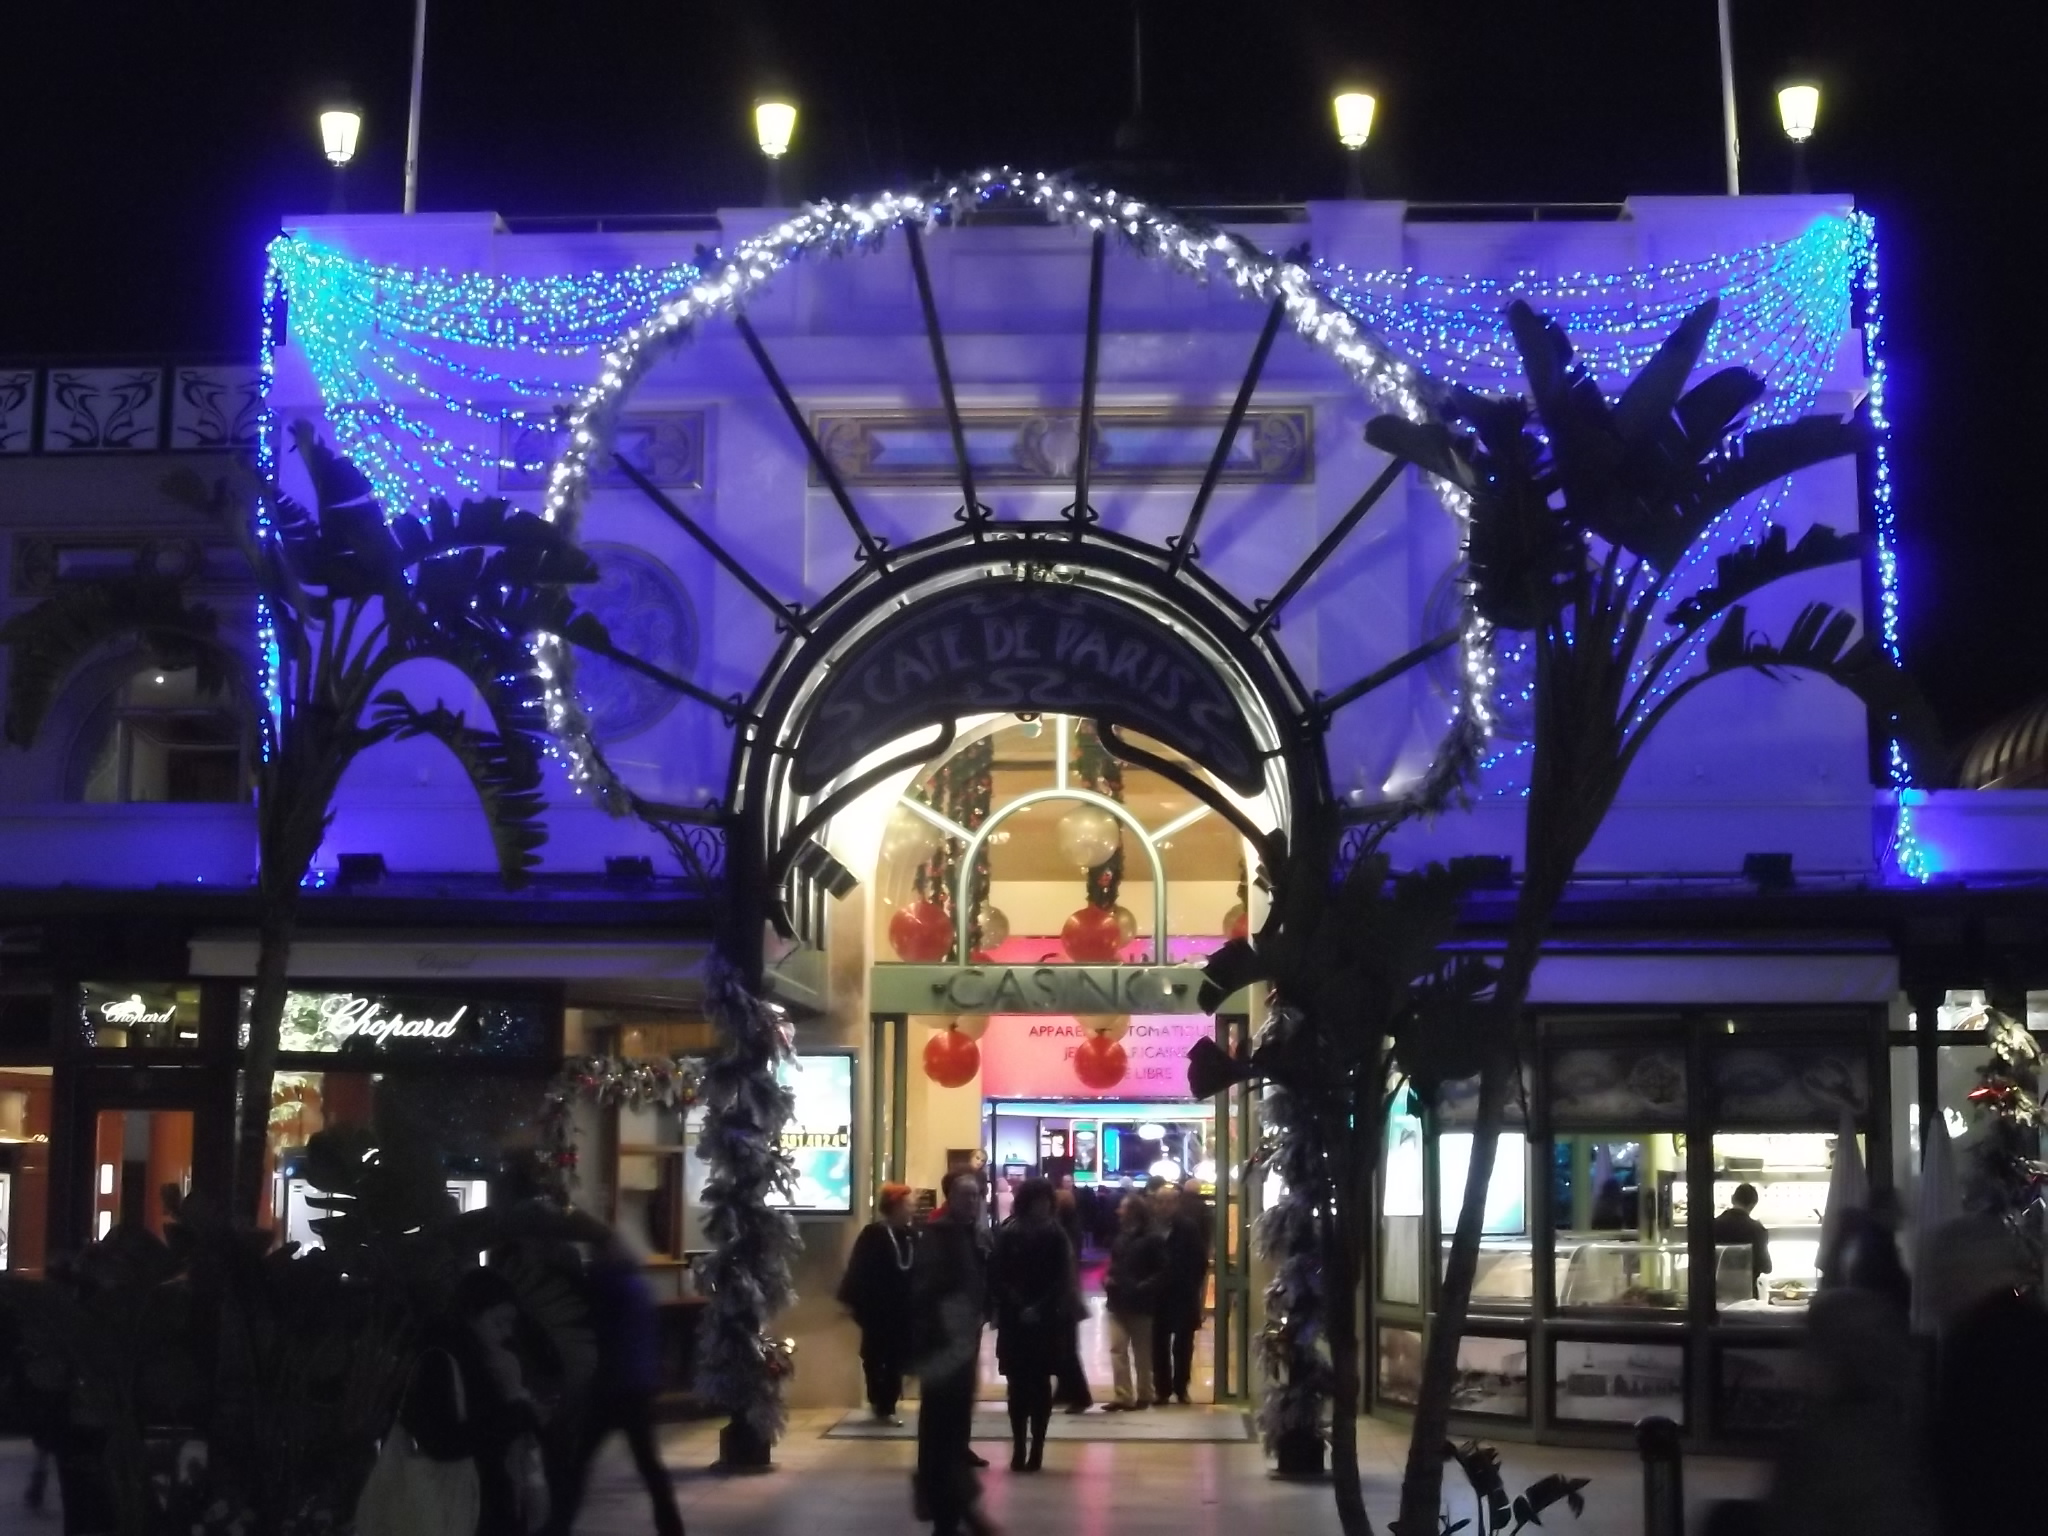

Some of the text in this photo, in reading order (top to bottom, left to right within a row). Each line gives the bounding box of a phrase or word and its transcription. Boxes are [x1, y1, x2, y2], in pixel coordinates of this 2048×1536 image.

[982, 616, 1041, 662] DE
[1055, 616, 1199, 710] PARIS
[101, 1001, 176, 1027] Chopard
[320, 997, 467, 1044] Chopard
[1135, 1067, 1172, 1080] LIBRE
